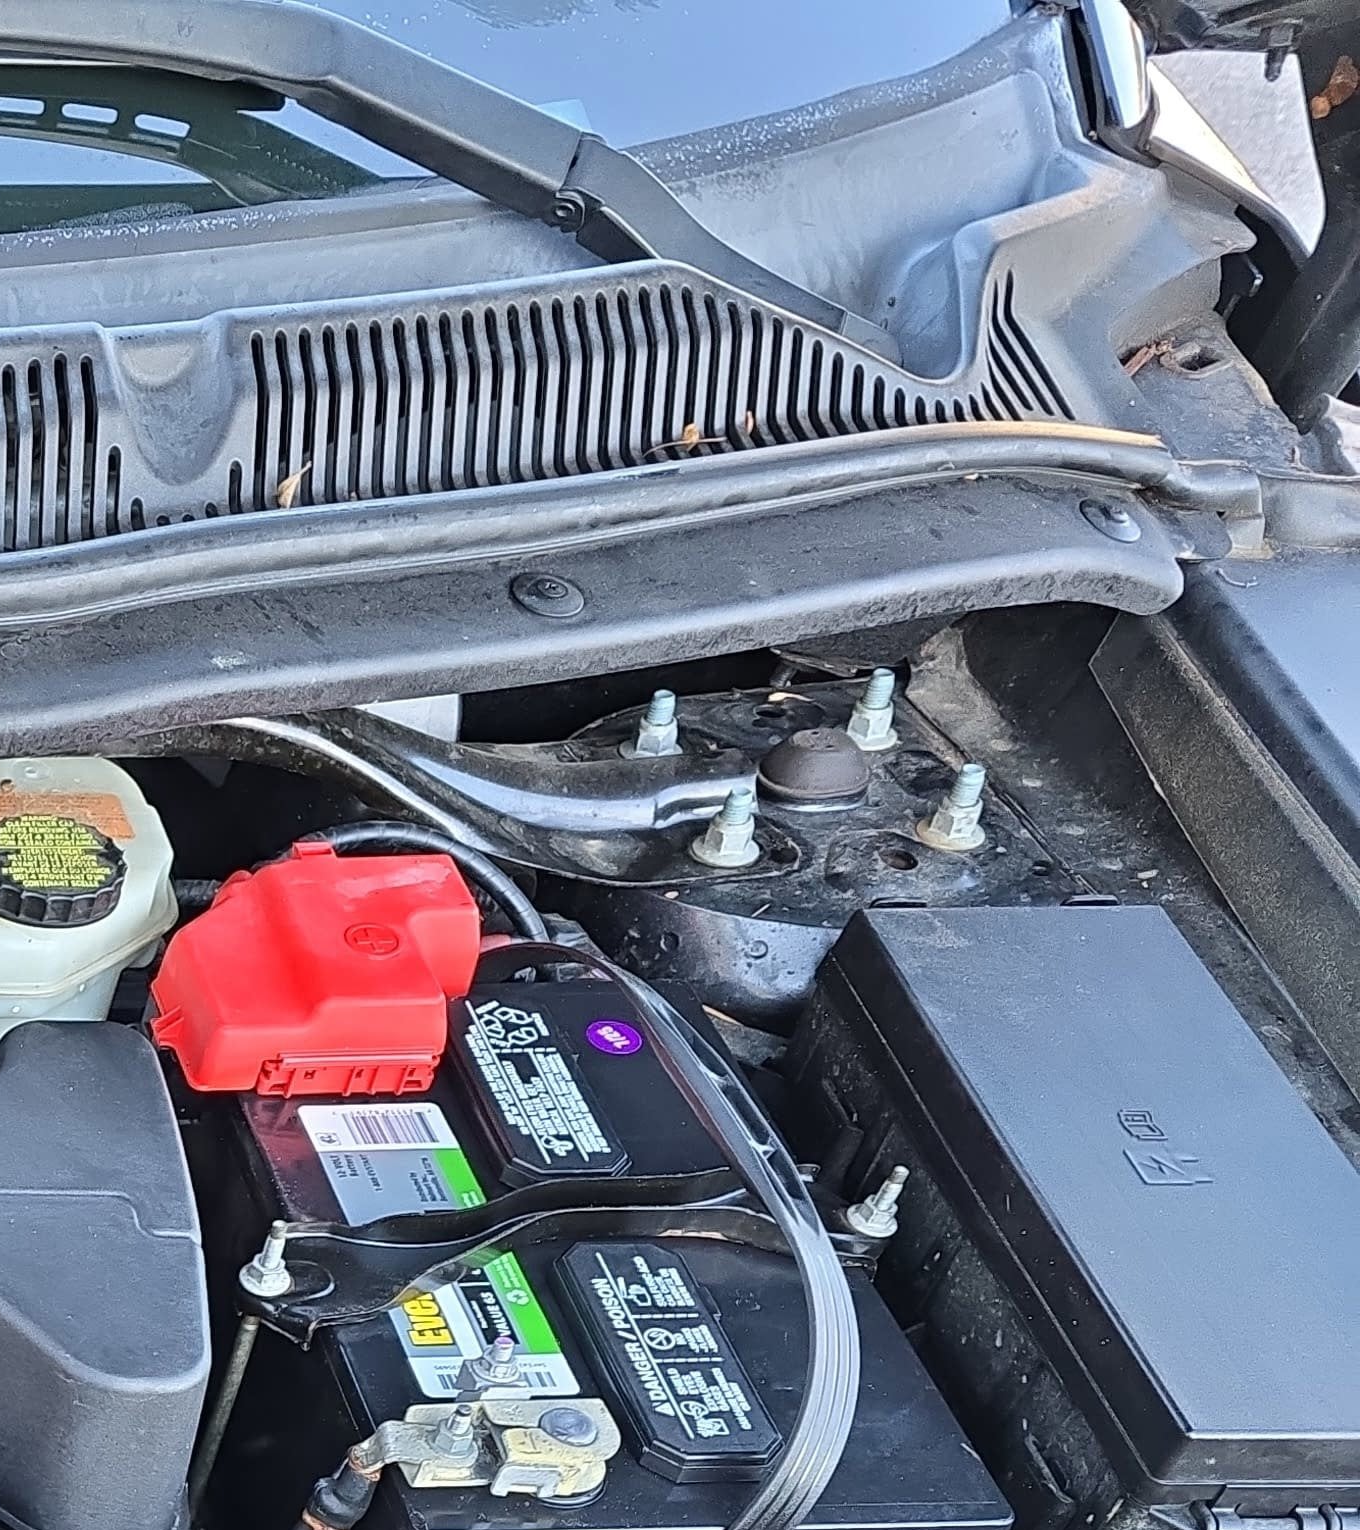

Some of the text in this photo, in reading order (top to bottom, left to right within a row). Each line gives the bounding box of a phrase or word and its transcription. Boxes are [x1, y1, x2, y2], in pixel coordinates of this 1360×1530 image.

[340, 1154, 360, 1176] Battery
[484, 1305, 513, 1336] VALUE
[590, 1278, 668, 1400] DANGER / POISON
